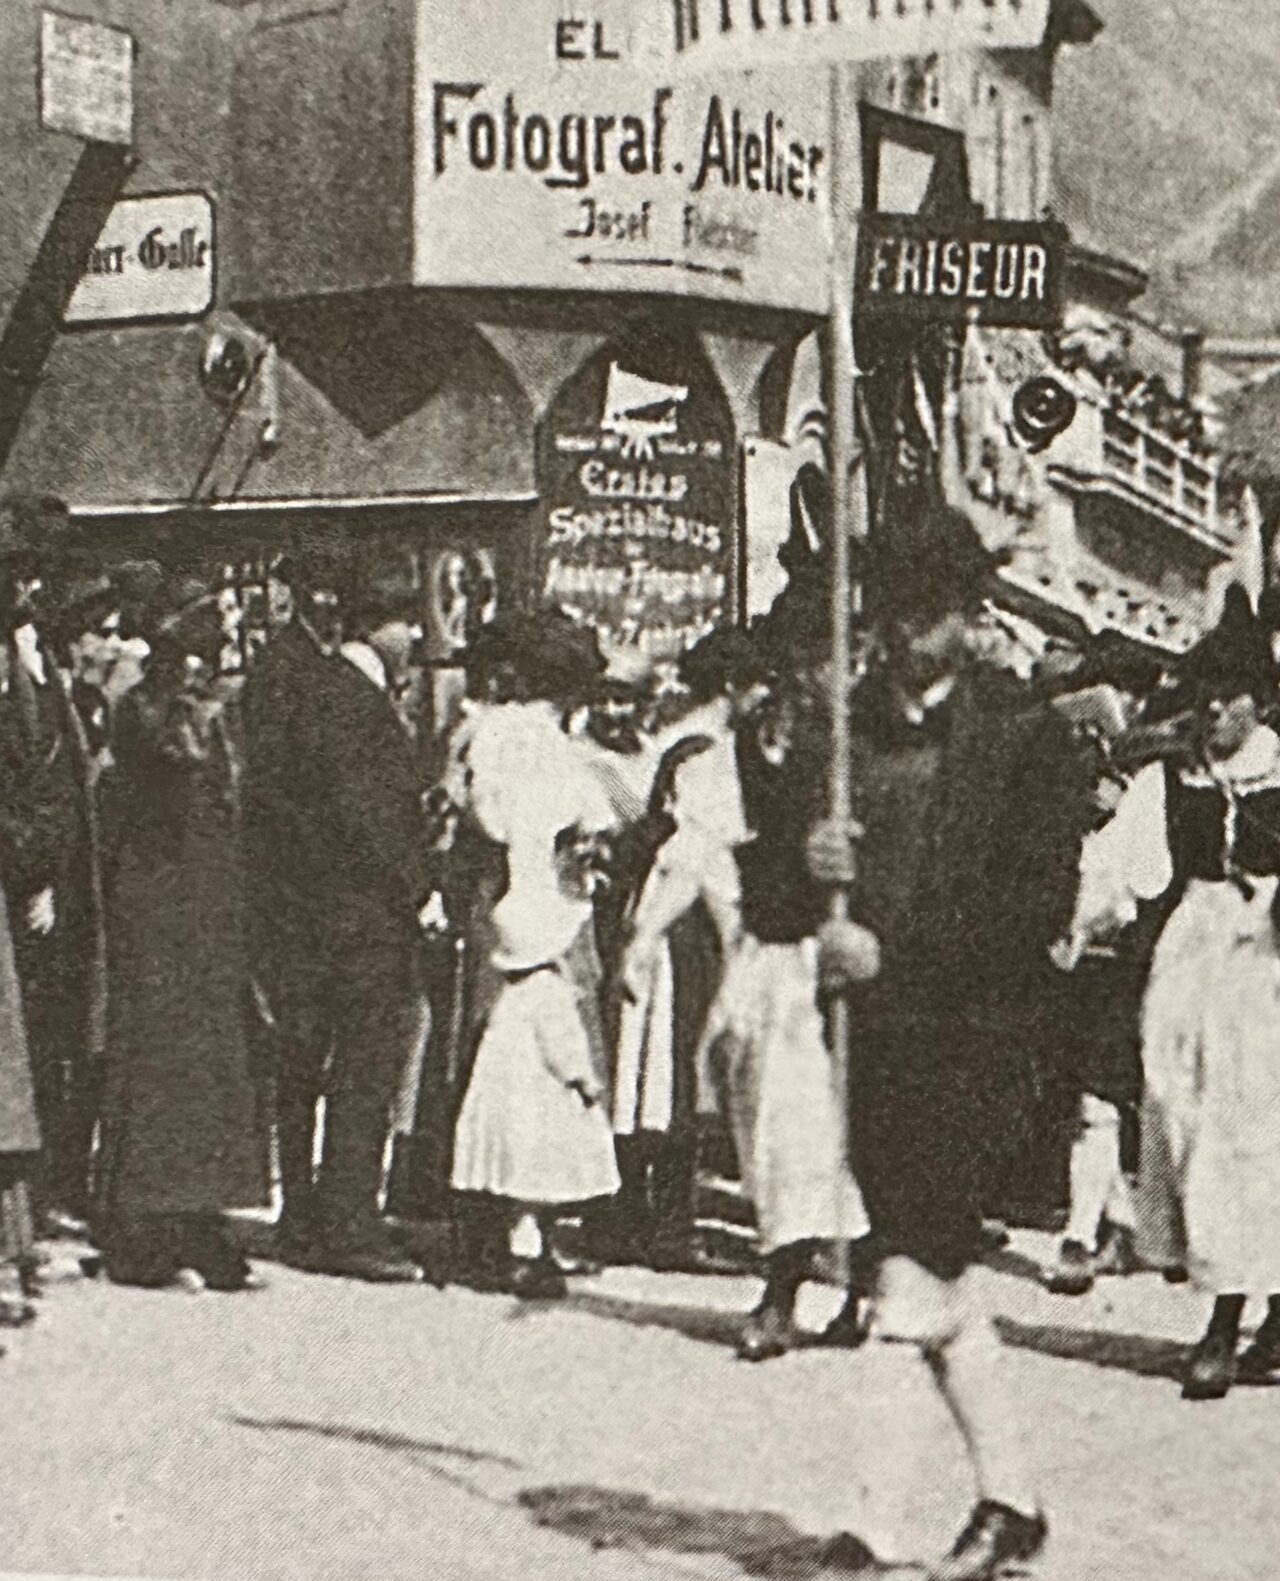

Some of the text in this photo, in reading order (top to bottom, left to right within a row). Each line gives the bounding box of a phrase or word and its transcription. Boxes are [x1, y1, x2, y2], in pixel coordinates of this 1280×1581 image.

[555, 18, 620, 60] EL
[433, 81, 824, 203] Fotograf. Atelier
[869, 236, 1047, 300] FRISEUR
